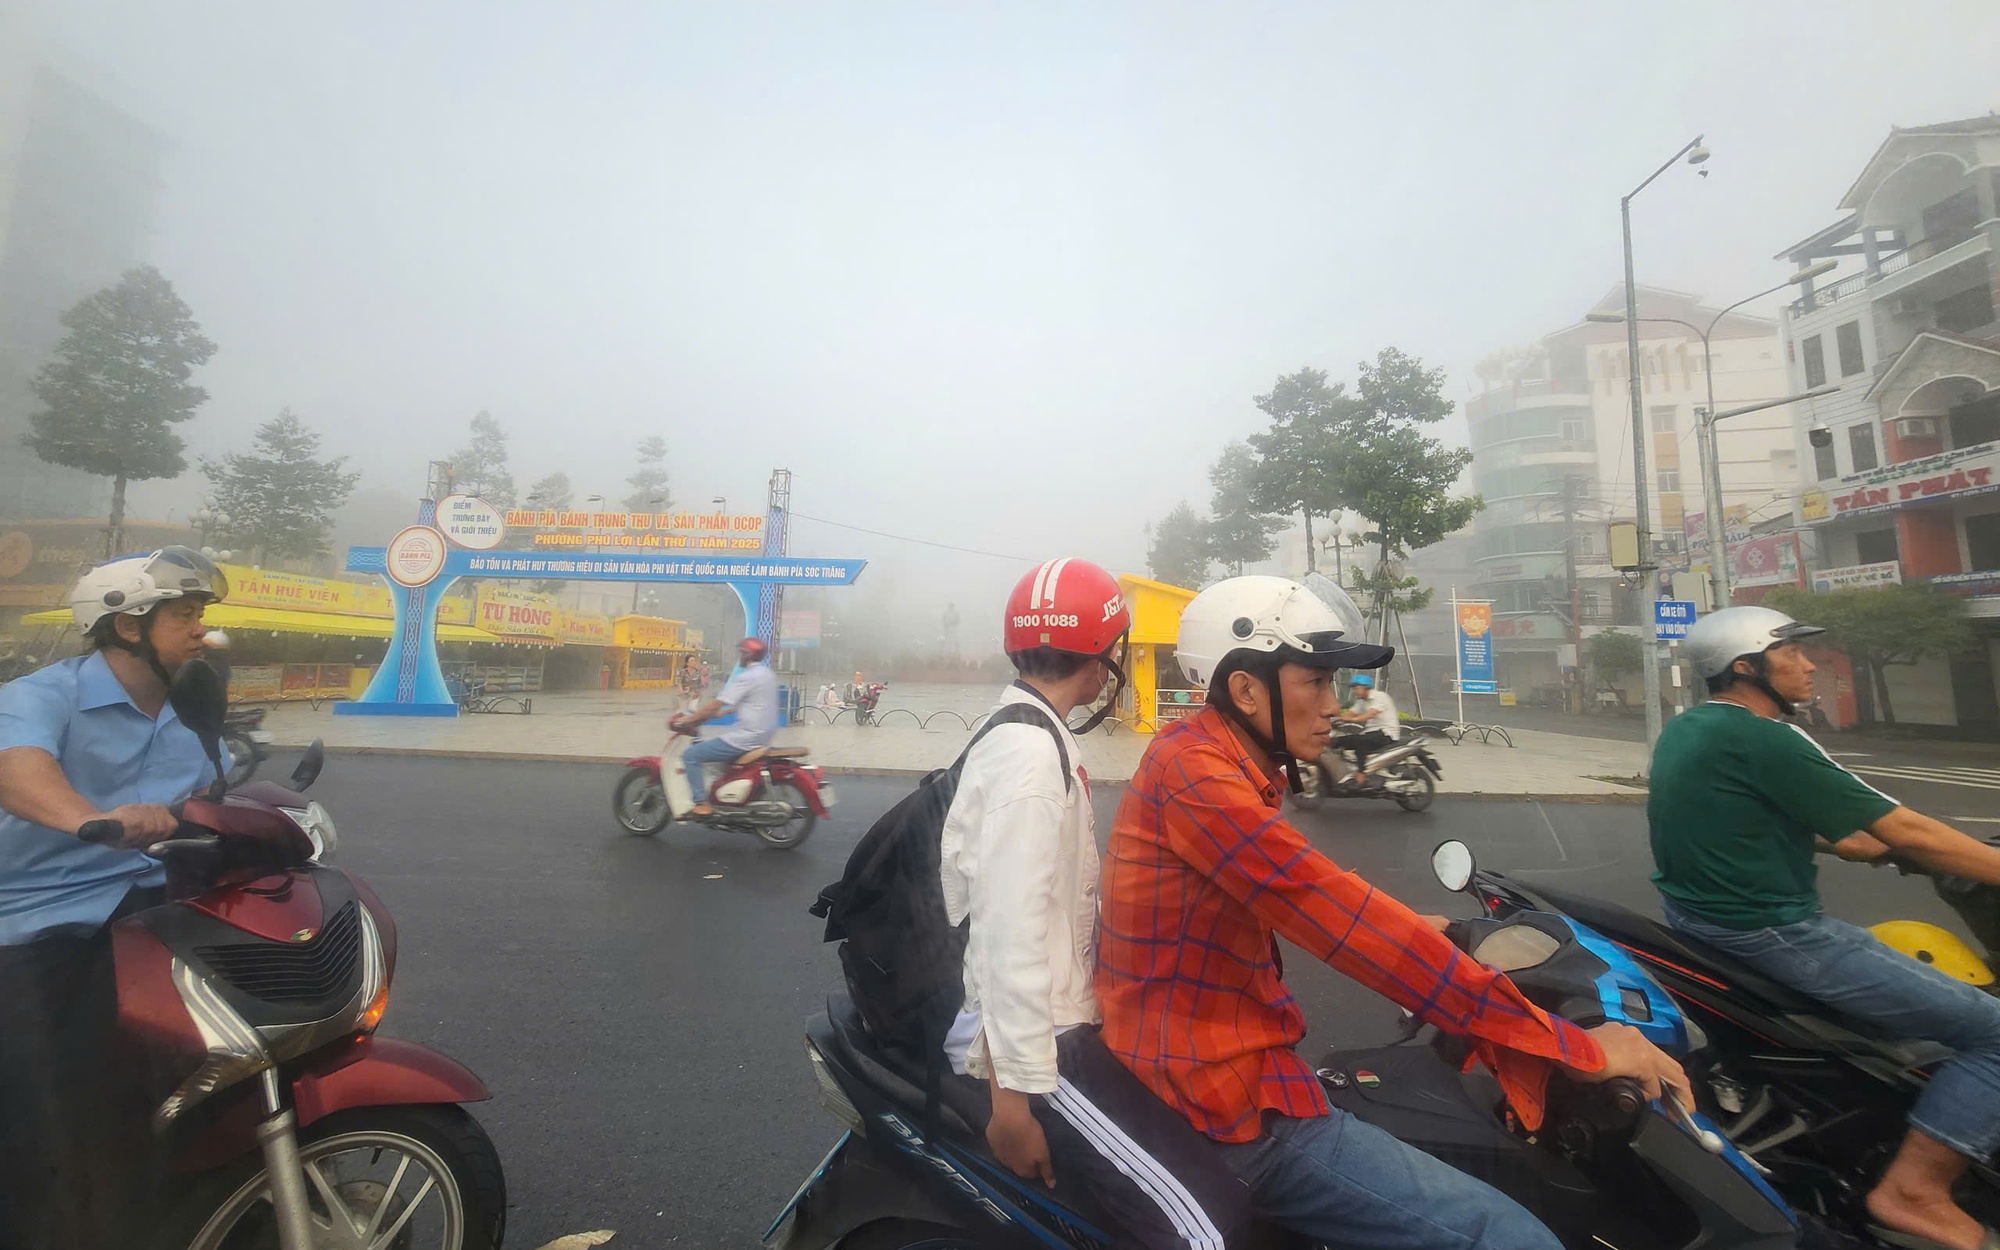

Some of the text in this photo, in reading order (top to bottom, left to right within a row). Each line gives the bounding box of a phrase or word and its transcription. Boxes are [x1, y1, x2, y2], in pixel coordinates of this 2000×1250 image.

[1898, 467, 1992, 499] PHÁT
[453, 501, 471, 510] ĐIỂM
[506, 509, 763, 531] BÁNH PÍA BÁNH TRUNG THU VÀ SẢN PHẨM OCOP
[461, 526, 476, 534] GIỚI
[477, 527, 497, 537] THIỆU
[534, 532, 761, 550] PHƯỜNG PHÚ LỢI LẦN THỨ I NĂM 2025
[470, 556, 484, 570] BẢO
[486, 556, 500, 571] TỒN
[501, 558, 511, 571] VÀ
[512, 558, 531, 571] PHÁT
[532, 560, 546, 571] HUY
[547, 560, 576, 572] THƯƠNG
[576, 560, 594, 574] HIỆU
[594, 562, 602, 573] DI
[603, 559, 619, 573] SẢN
[620, 561, 635, 574] VĂN
[635, 561, 650, 574] HÓA
[652, 563, 664, 574] PHI
[666, 563, 679, 576] VẬT
[681, 560, 695, 575] THỂ
[695, 561, 715, 576] QUỐC
[716, 564, 729, 576] GIA
[751, 563, 768, 577] LÀM
[769, 564, 789, 577] BÁNH
[790, 565, 803, 578] PÍA
[805, 566, 820, 578] SÓC
[821, 565, 846, 579] TRĂNG
[239, 578, 271, 594] TÂN
[275, 585, 303, 598] HUÊ
[309, 588, 339, 602] VIÊN
[483, 602, 552, 626] TƯ HỒNG
[1102, 593, 1121, 623] J&T
[1660, 603, 1670, 617] CẤM
[1670, 606, 1677, 617] XE
[1012, 614, 1079, 628] 1900 1088
